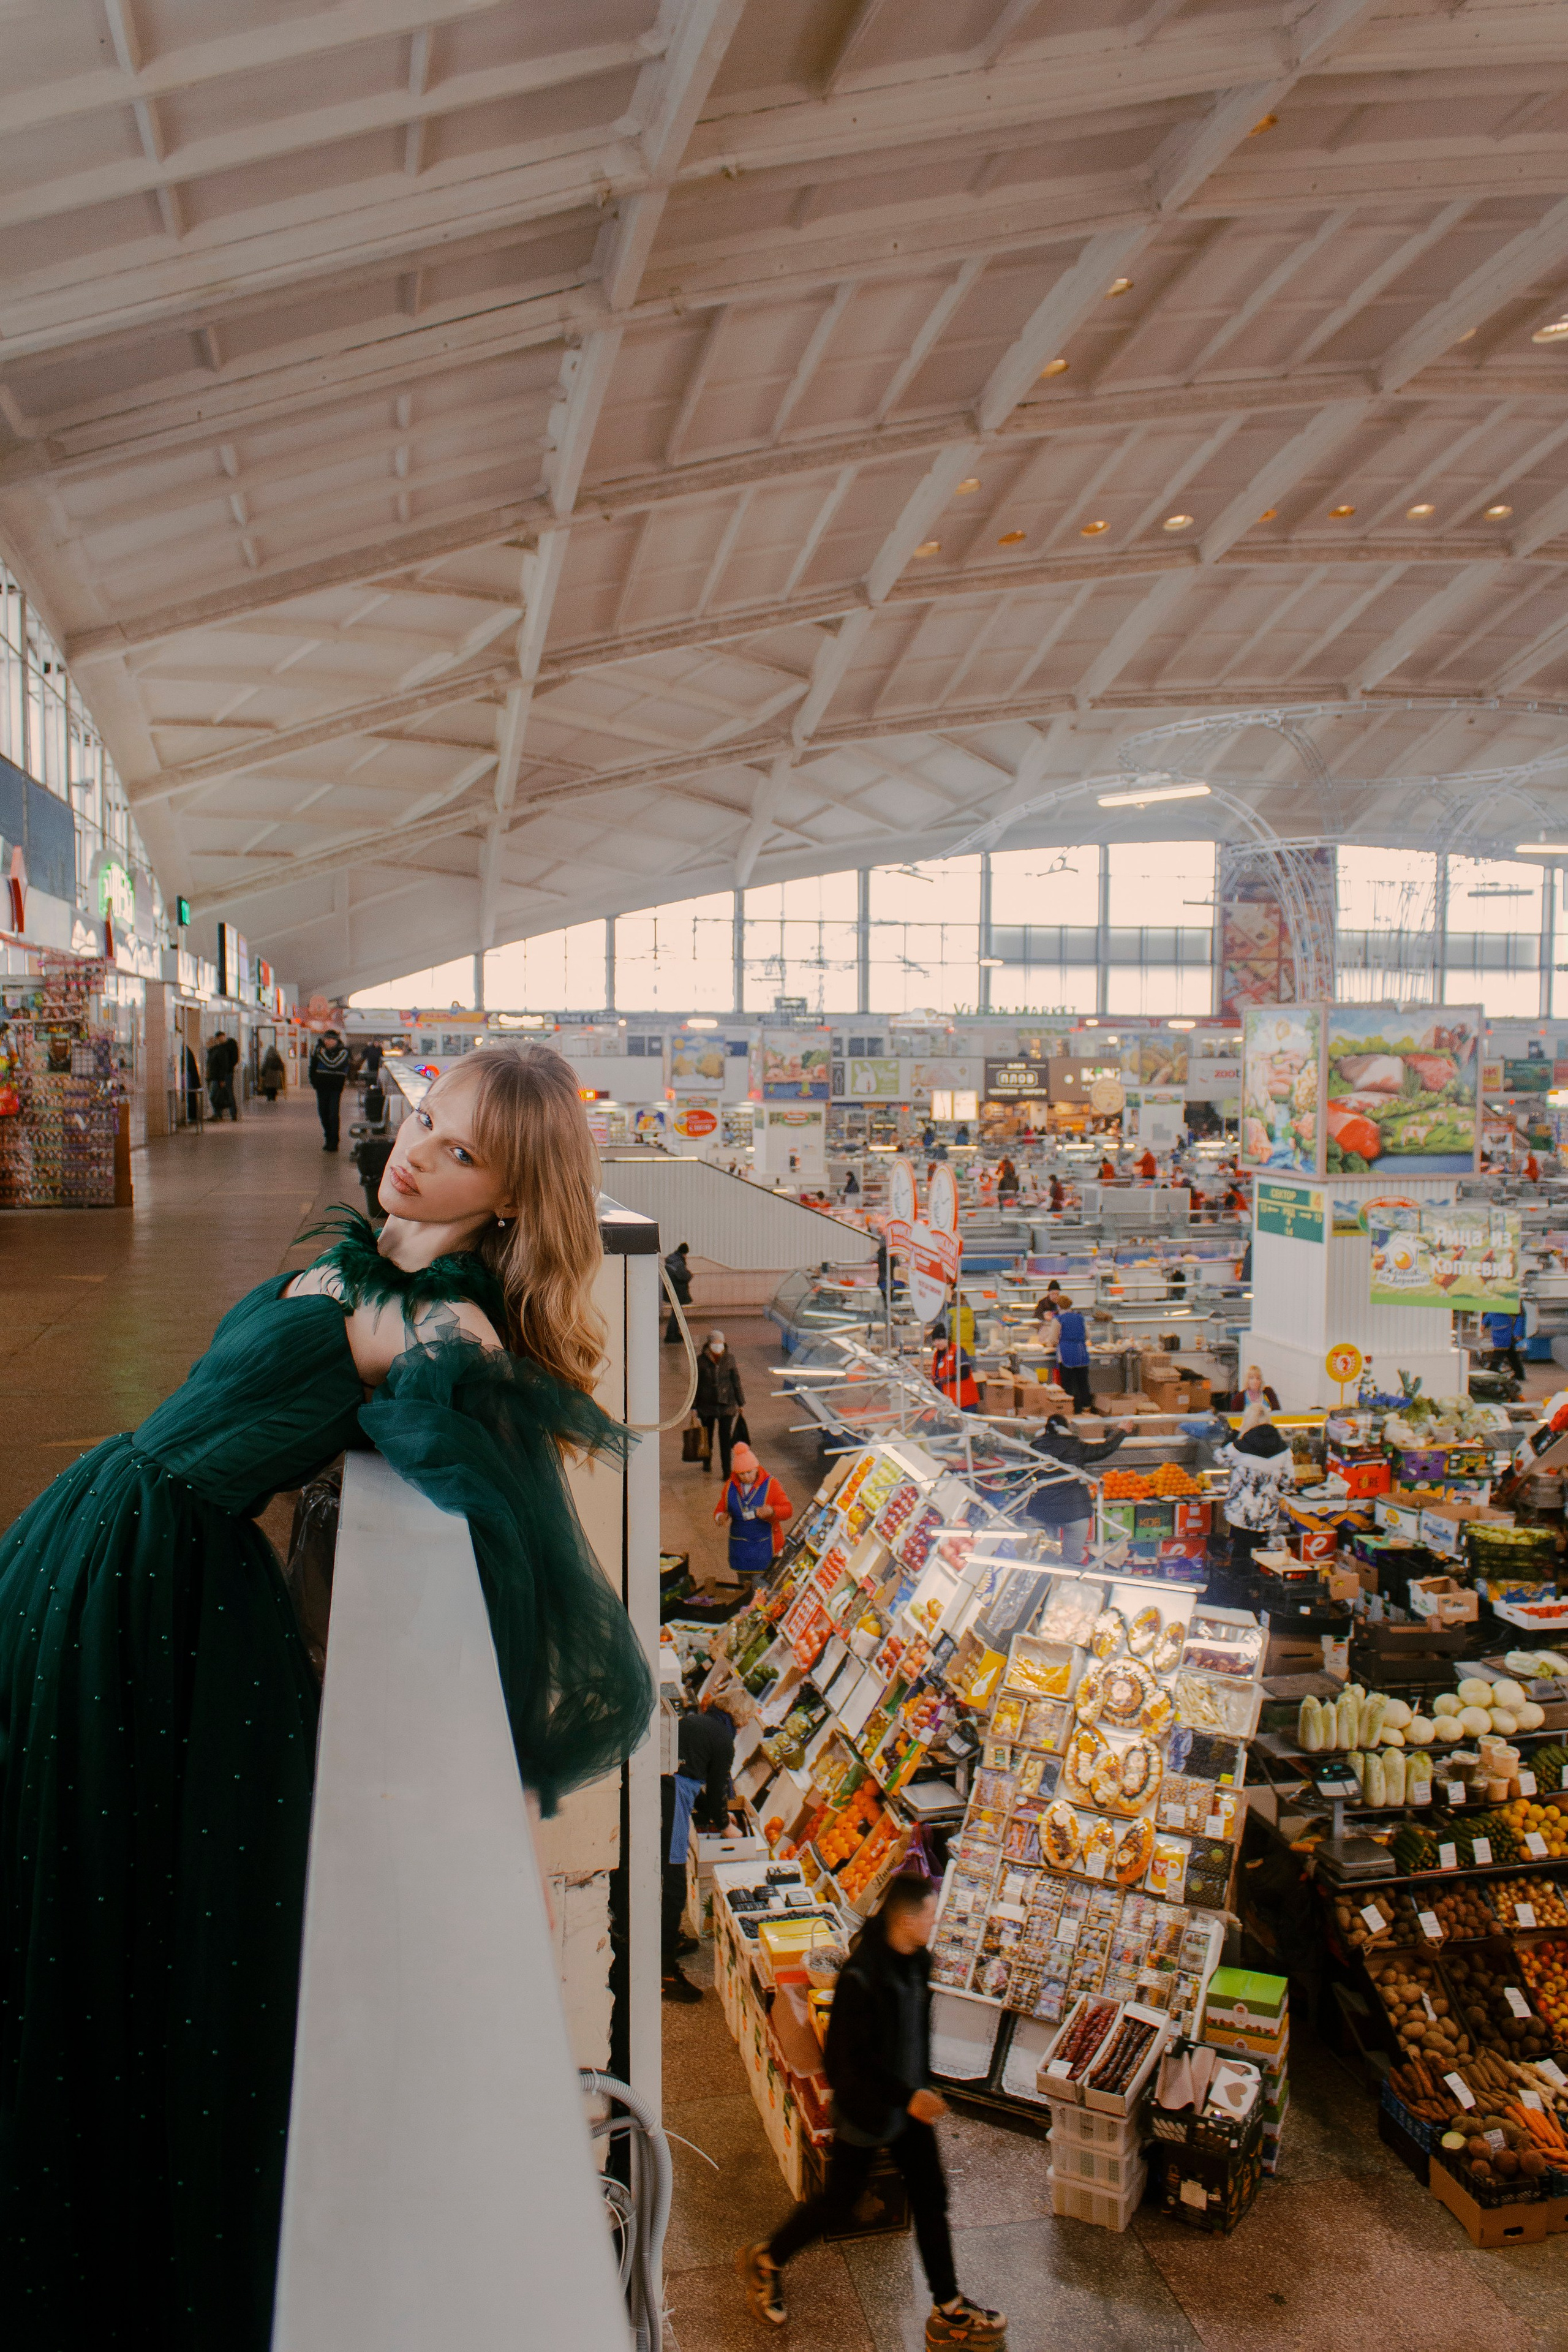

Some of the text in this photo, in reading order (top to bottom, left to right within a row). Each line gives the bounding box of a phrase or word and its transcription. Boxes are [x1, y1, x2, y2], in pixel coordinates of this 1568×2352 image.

[954, 1003, 1077, 1016] VEGAN MARKET
[1000, 1073, 1035, 1085] ПЛОВ
[1490, 1231, 1512, 1248] из
